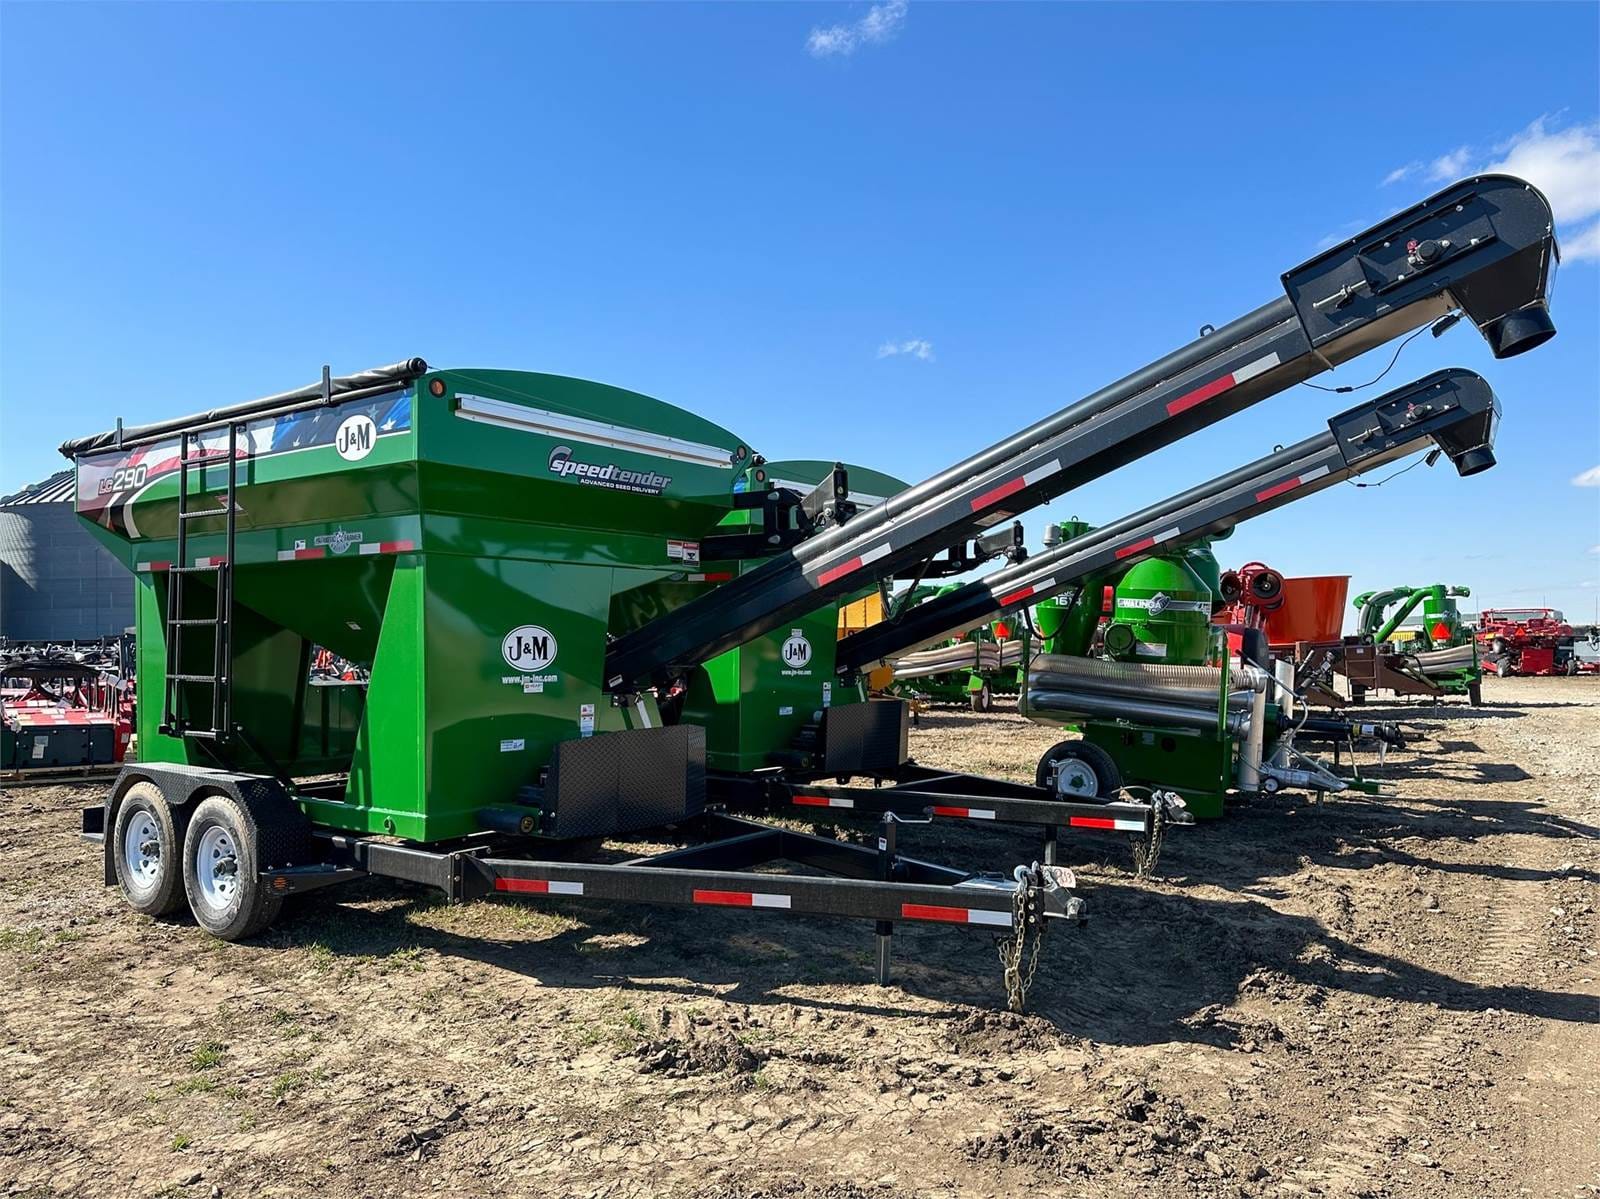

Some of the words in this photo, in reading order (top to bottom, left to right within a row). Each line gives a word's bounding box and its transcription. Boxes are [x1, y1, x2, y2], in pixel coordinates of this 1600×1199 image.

[338, 422, 371, 454] J&M
[580, 478, 615, 489] ADVANCED
[615, 483, 631, 491] SEED
[631, 486, 659, 495] DELIVERY
[508, 636, 549, 661] J&M
[785, 643, 807, 661] J&M
[501, 674, 558, 685] www.jm-inc.com
